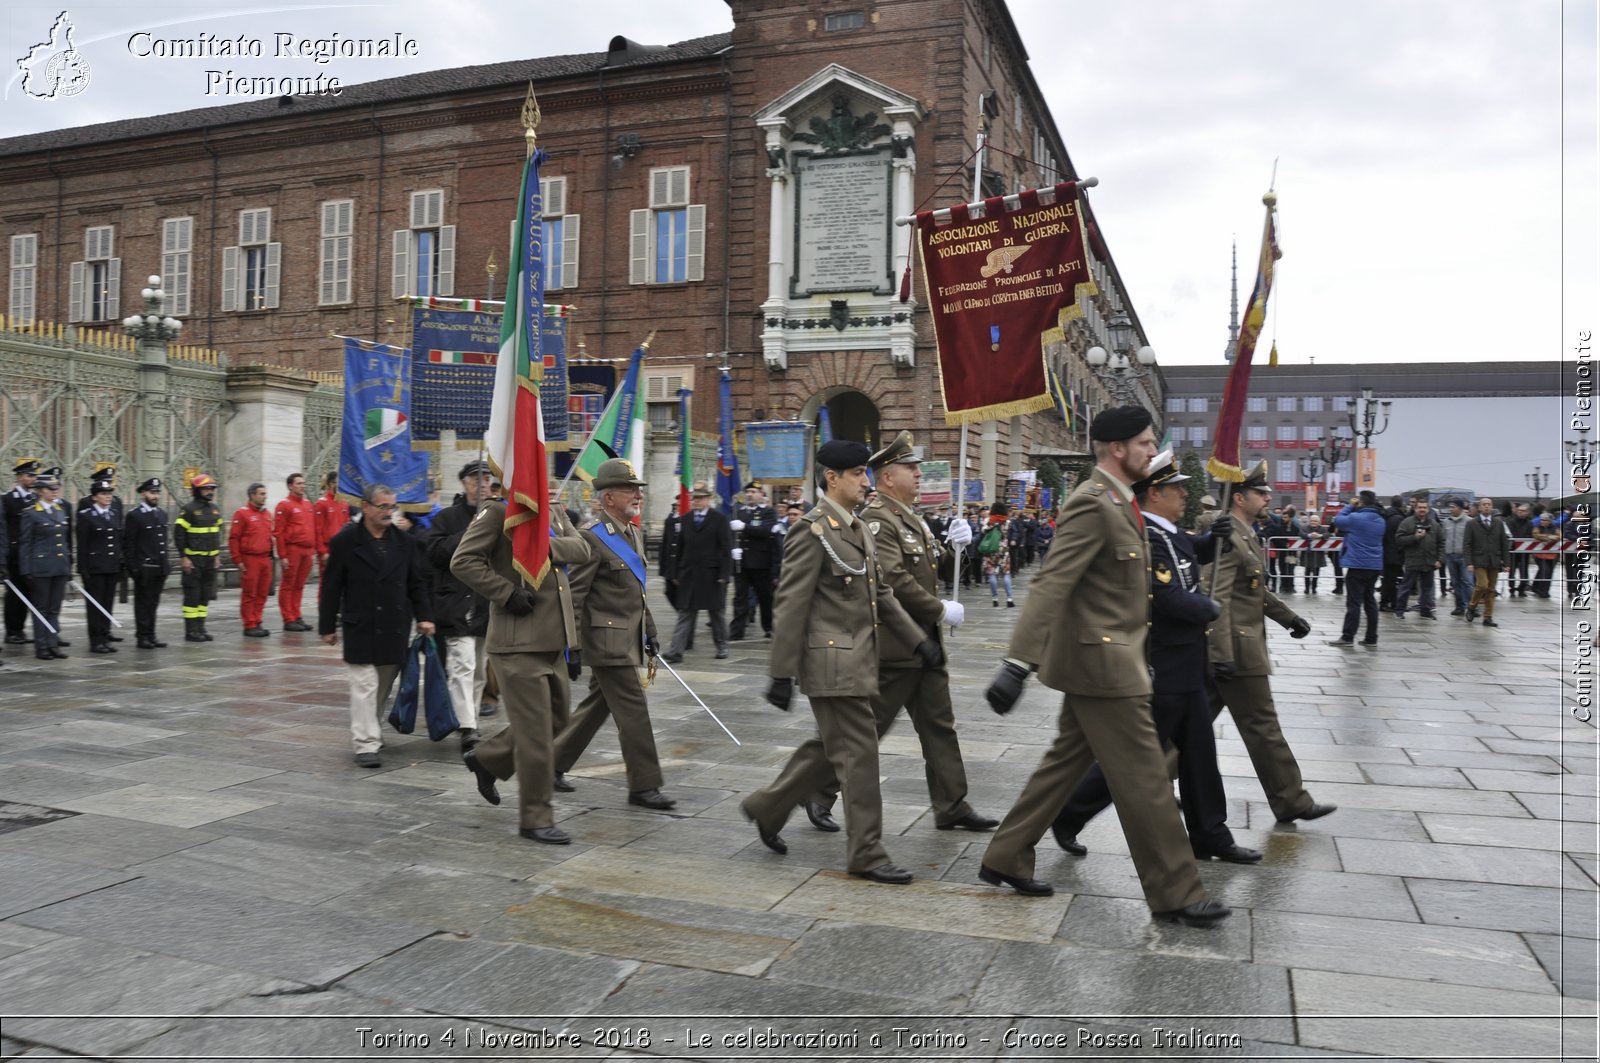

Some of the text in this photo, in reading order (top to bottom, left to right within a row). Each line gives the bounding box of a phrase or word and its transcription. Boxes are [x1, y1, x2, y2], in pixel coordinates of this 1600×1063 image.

[929, 203, 1075, 246] ASSOCIAZIONE NAZIONALE
[938, 221, 1070, 259] VOLONTARI DI GUERRA
[937, 259, 1081, 297] FEDERAZIONE PROVINCIALE DI ASTI
[531, 311, 541, 361] TORINO
